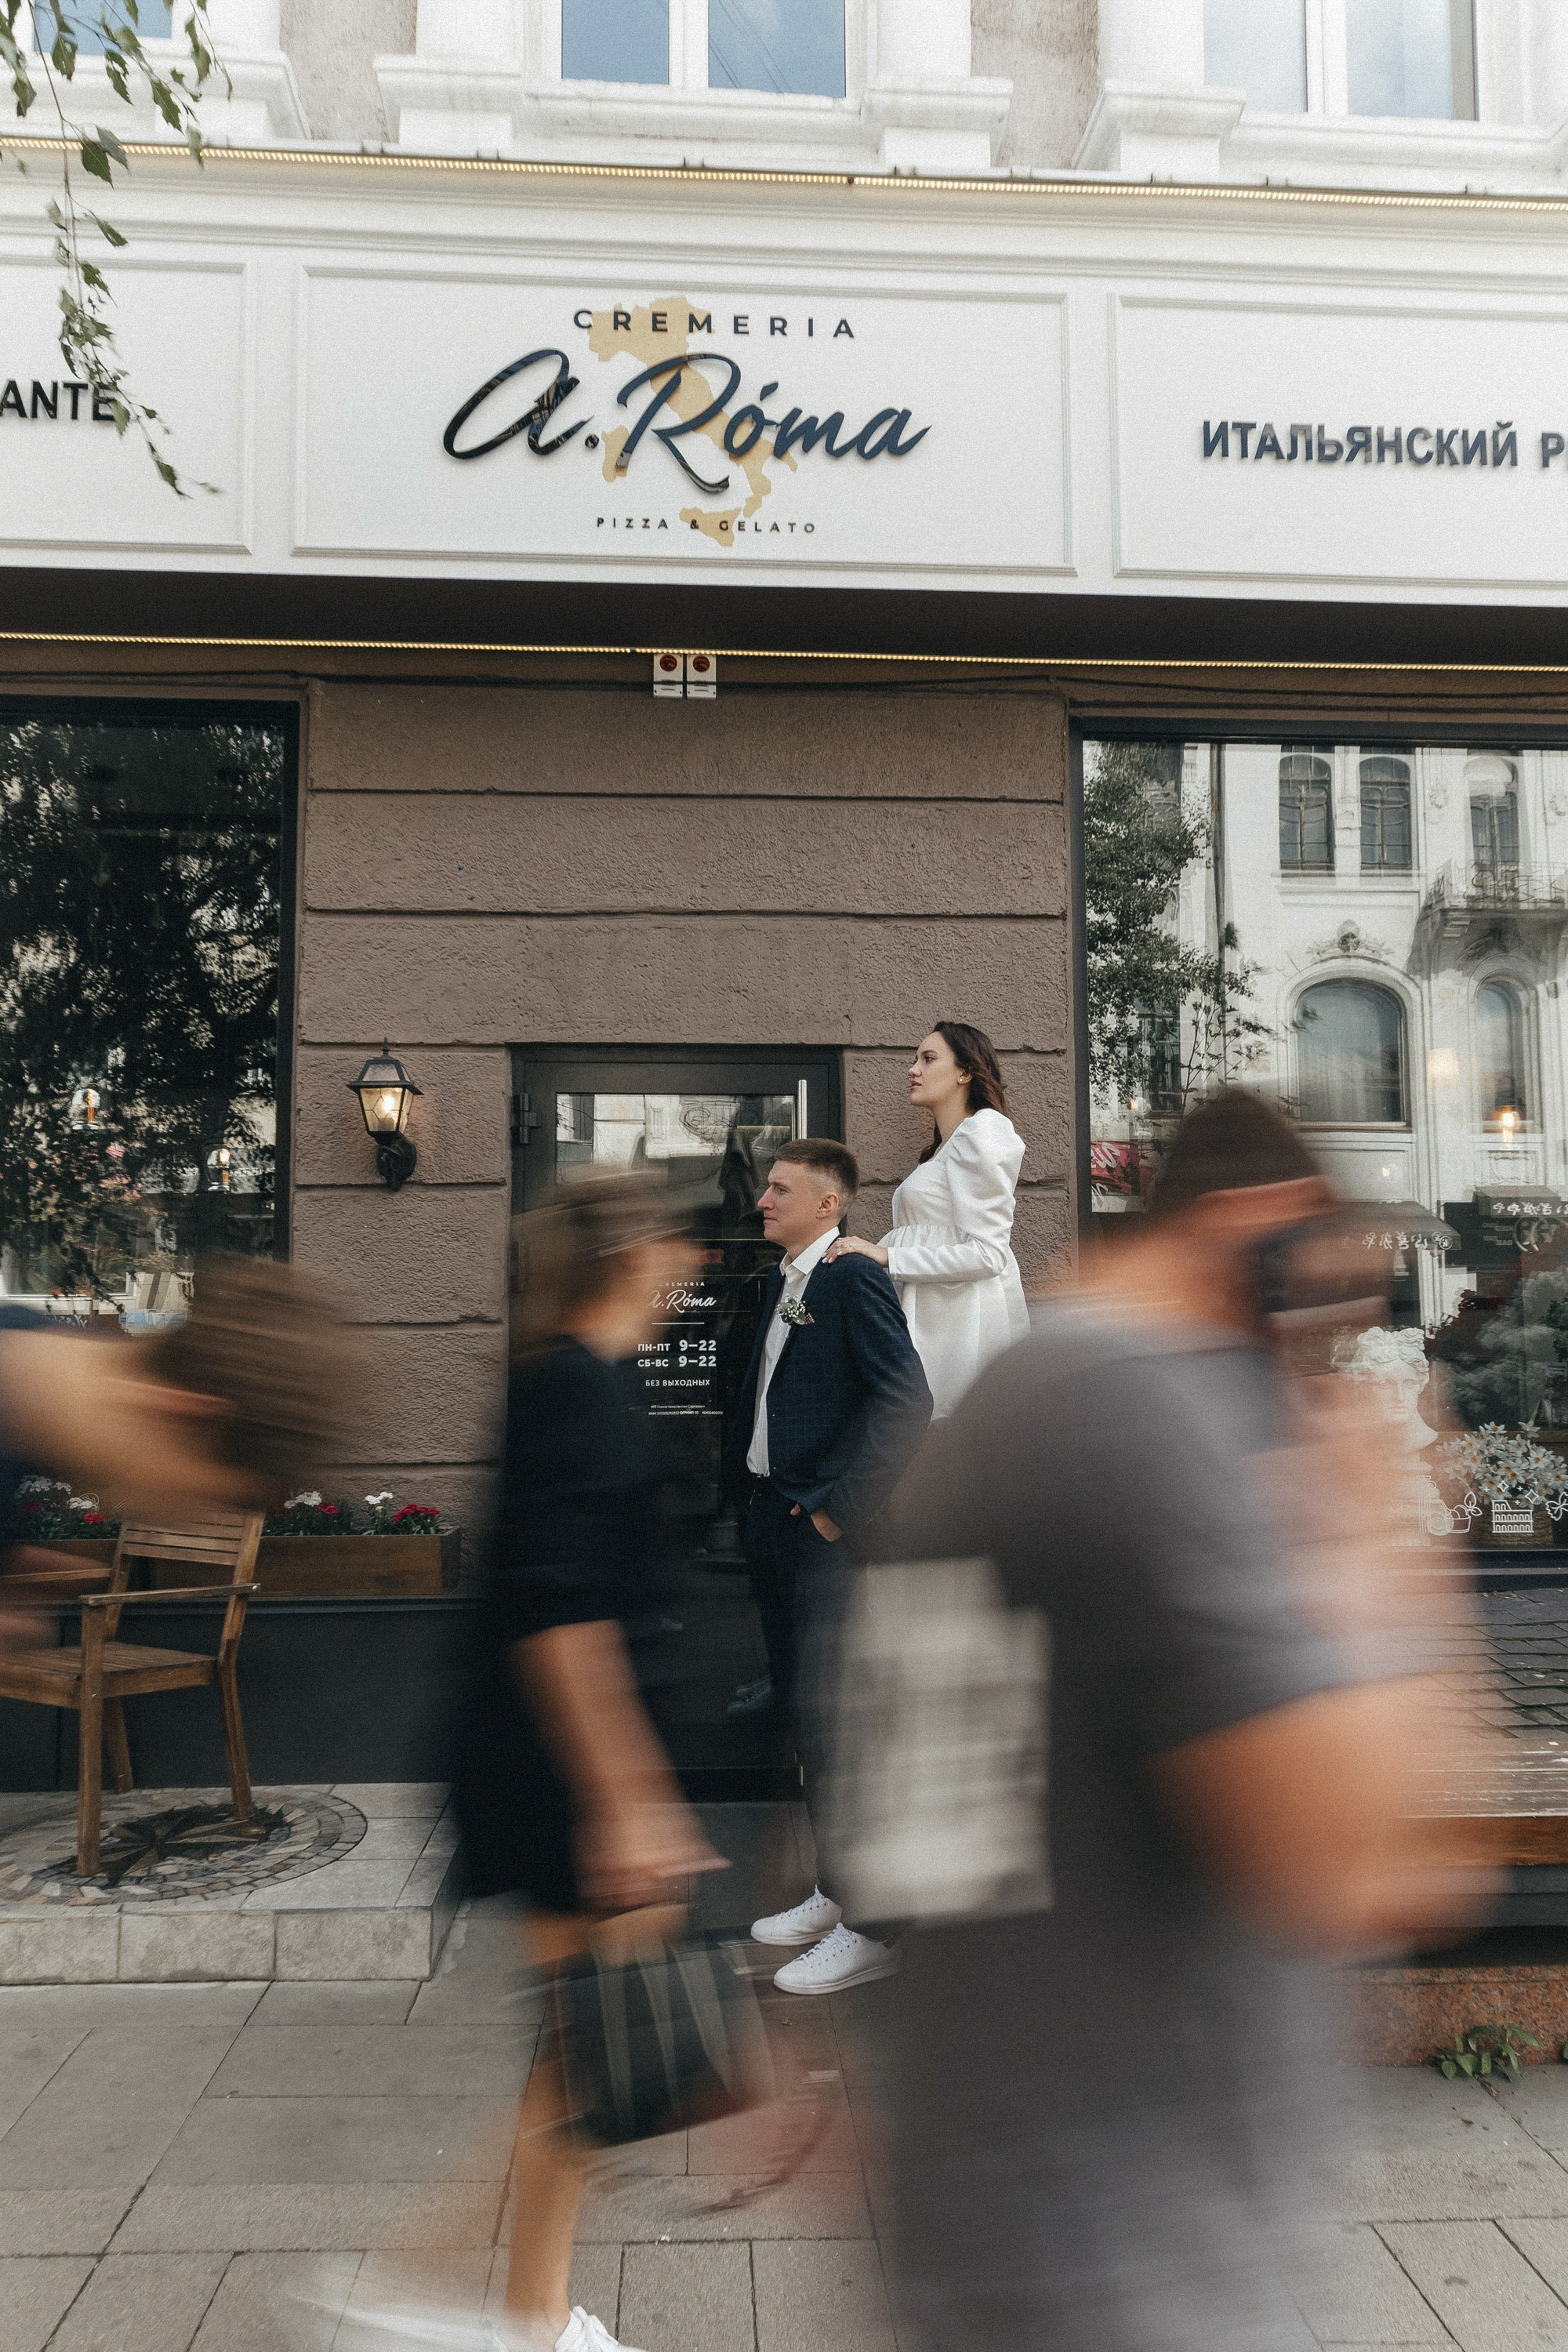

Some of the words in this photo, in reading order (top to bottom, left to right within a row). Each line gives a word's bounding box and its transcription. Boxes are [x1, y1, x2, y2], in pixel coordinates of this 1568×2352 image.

[573, 310, 854, 338] CREMERIA
[0, 379, 116, 421] ANTE
[1203, 420, 1518, 467] ИТАЛЬЯНСКИЙ
[597, 517, 668, 529] PIZZA
[690, 519, 699, 530] &
[719, 520, 815, 533] GELATO
[637, 1343, 670, 1352] ПН-ПТ
[637, 1359, 669, 1367] СБ-ВС
